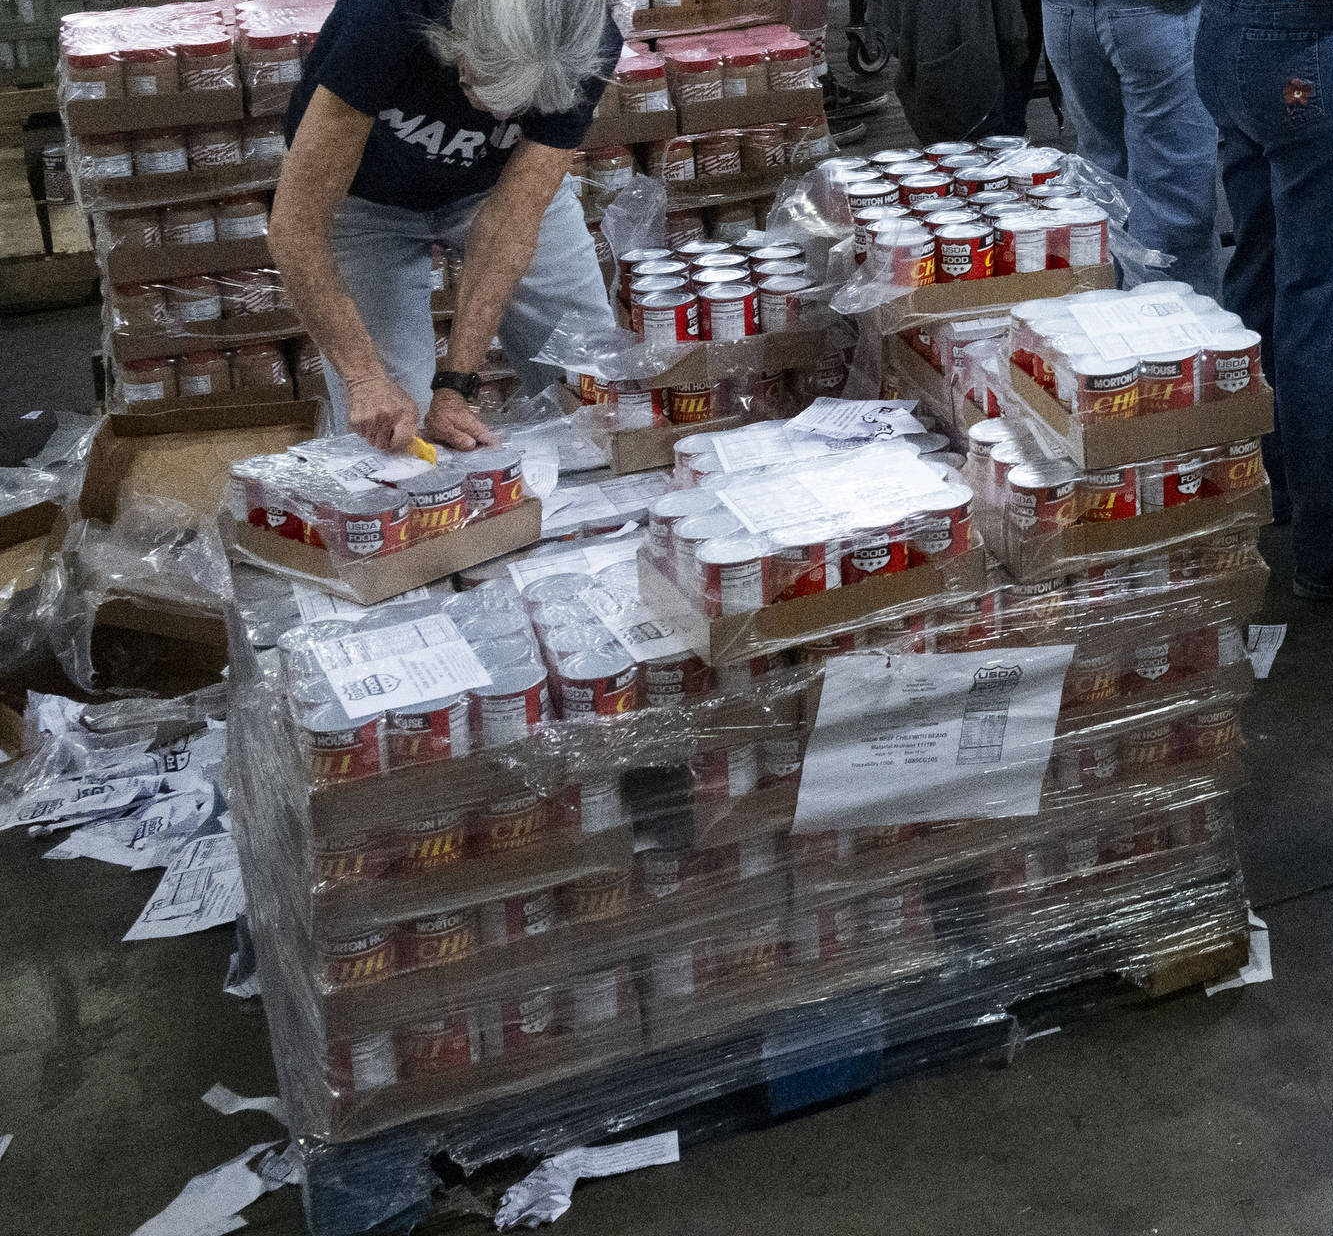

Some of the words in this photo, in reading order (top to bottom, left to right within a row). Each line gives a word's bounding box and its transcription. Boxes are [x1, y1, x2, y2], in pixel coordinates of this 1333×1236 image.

[850, 196, 883, 208] MORTON
[942, 246, 968, 256] USDA
[943, 255, 969, 264] FOOD
[1217, 358, 1247, 369] USDA
[1218, 369, 1250, 379] FOOD
[1094, 375, 1134, 389] MORTON
[435, 487, 463, 502] HOUSE
[347, 522, 378, 532] USDA
[348, 532, 380, 542] FOOD
[854, 548, 888, 559] FOOD
[978, 669, 1018, 680] USDA
